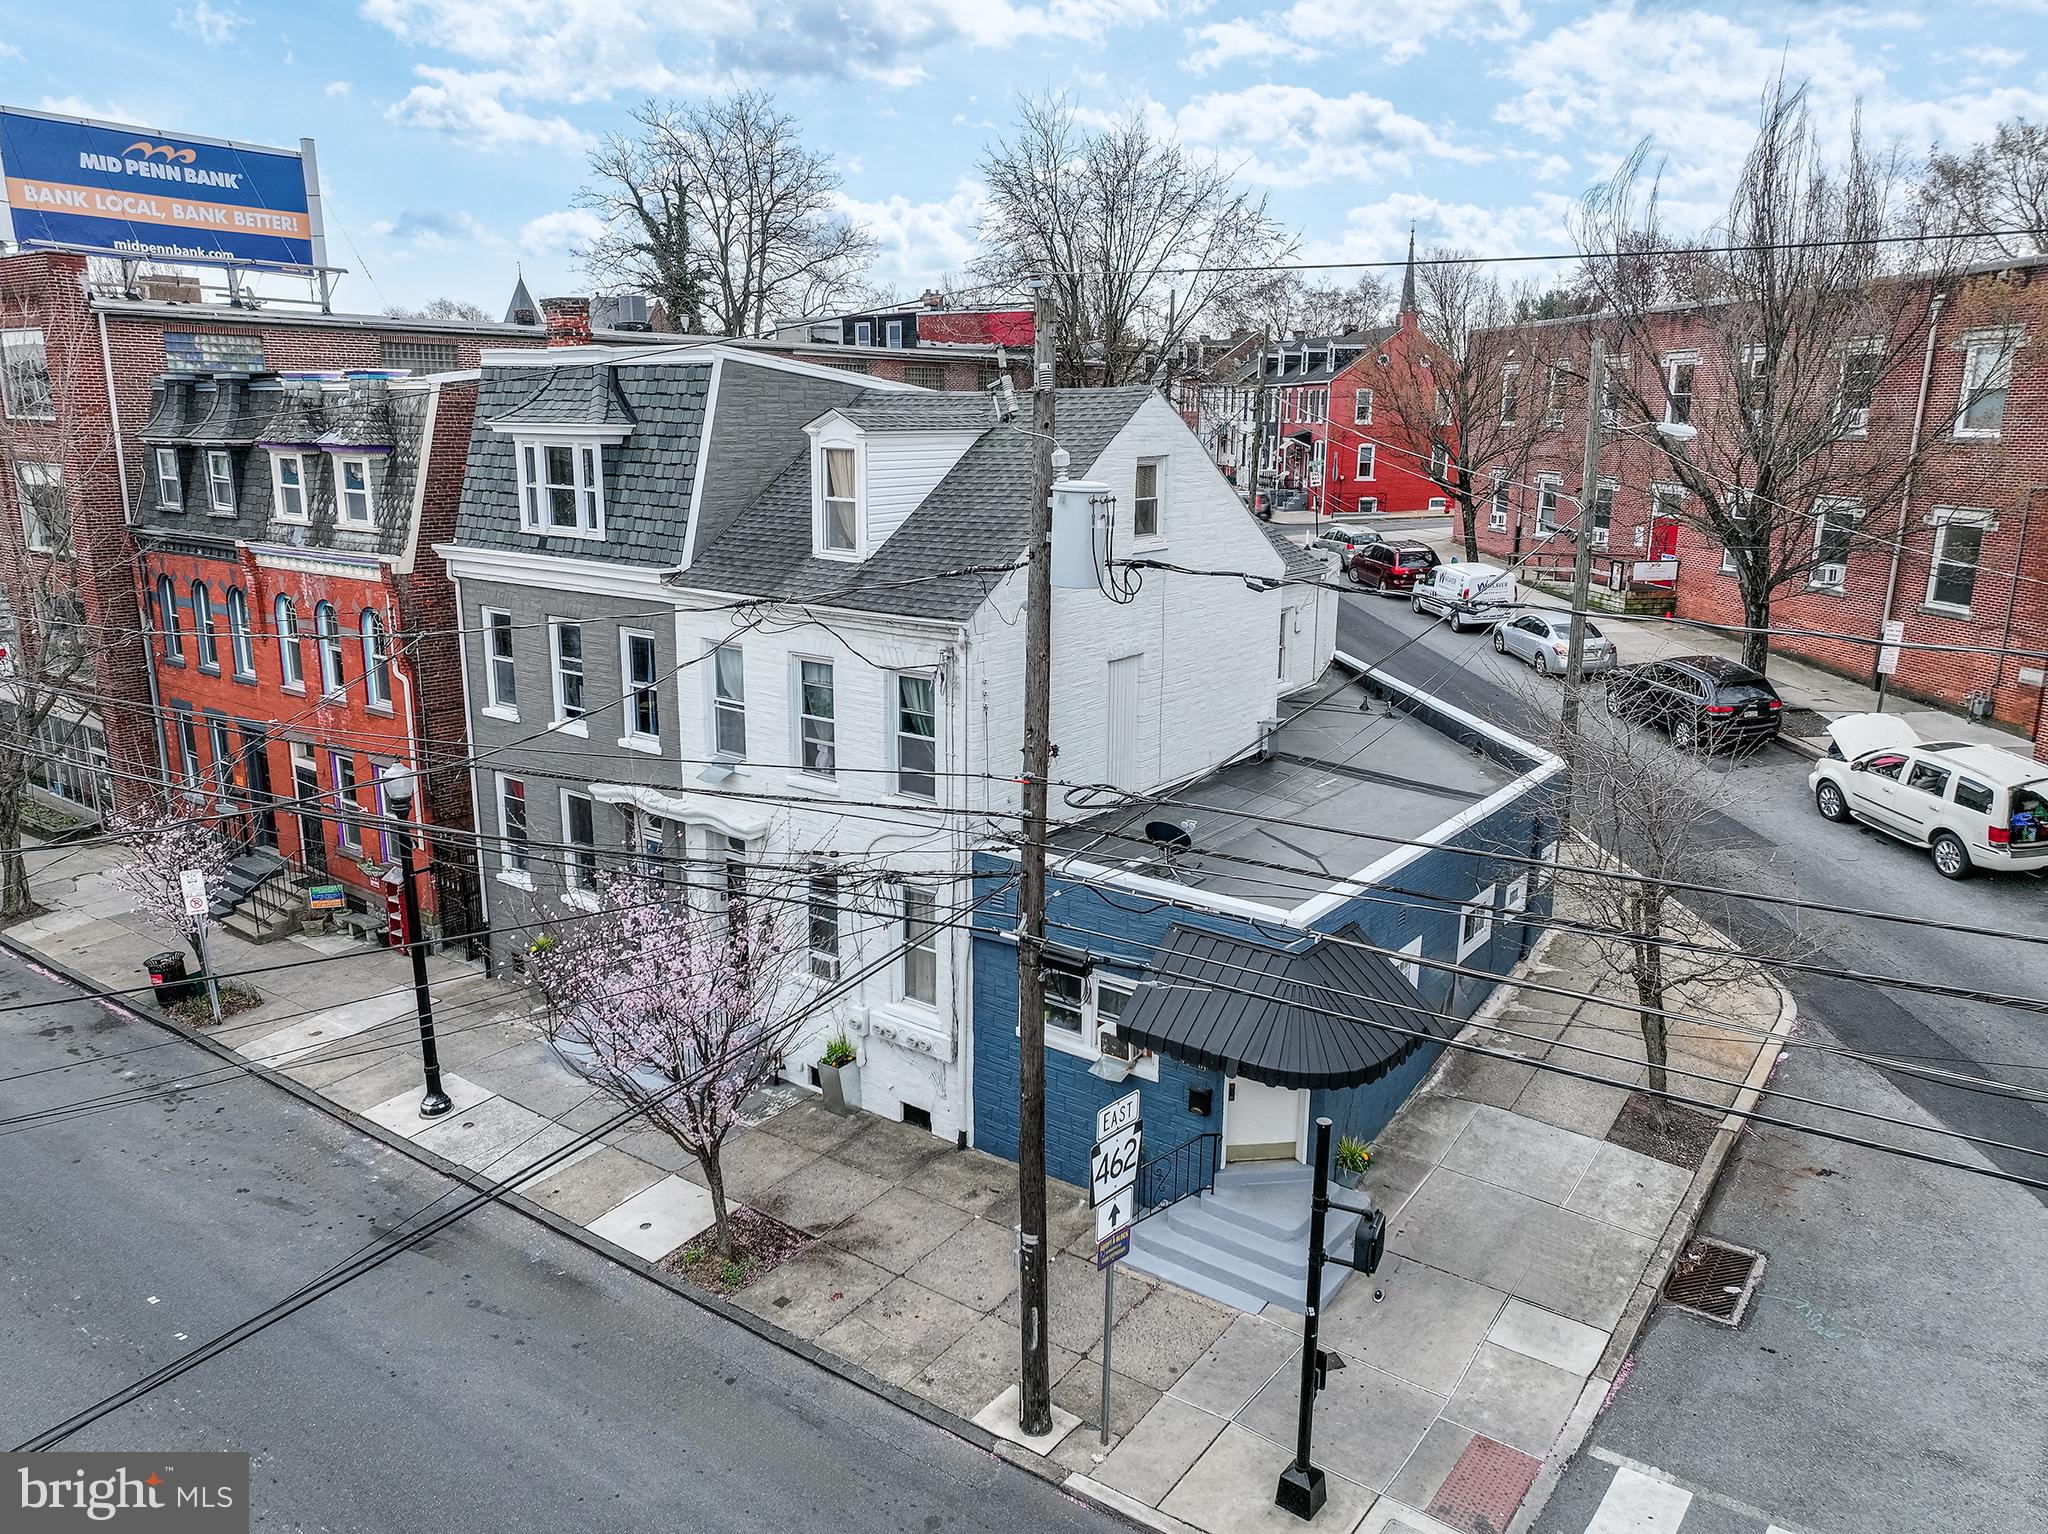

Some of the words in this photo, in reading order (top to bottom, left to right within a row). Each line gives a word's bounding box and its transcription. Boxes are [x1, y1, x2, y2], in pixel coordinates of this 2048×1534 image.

[80, 152, 122, 172] MID
[126, 160, 183, 182] PENN
[186, 168, 240, 190] BANK
[24, 184, 89, 208] BANK
[95, 193, 167, 220] LOCAL,
[172, 203, 228, 225] BANK
[234, 211, 298, 233] BETTER!
[113, 238, 236, 260] midpennbank.com
[1103, 1101, 1134, 1133] EAST
[1095, 1137, 1138, 1185] 462
